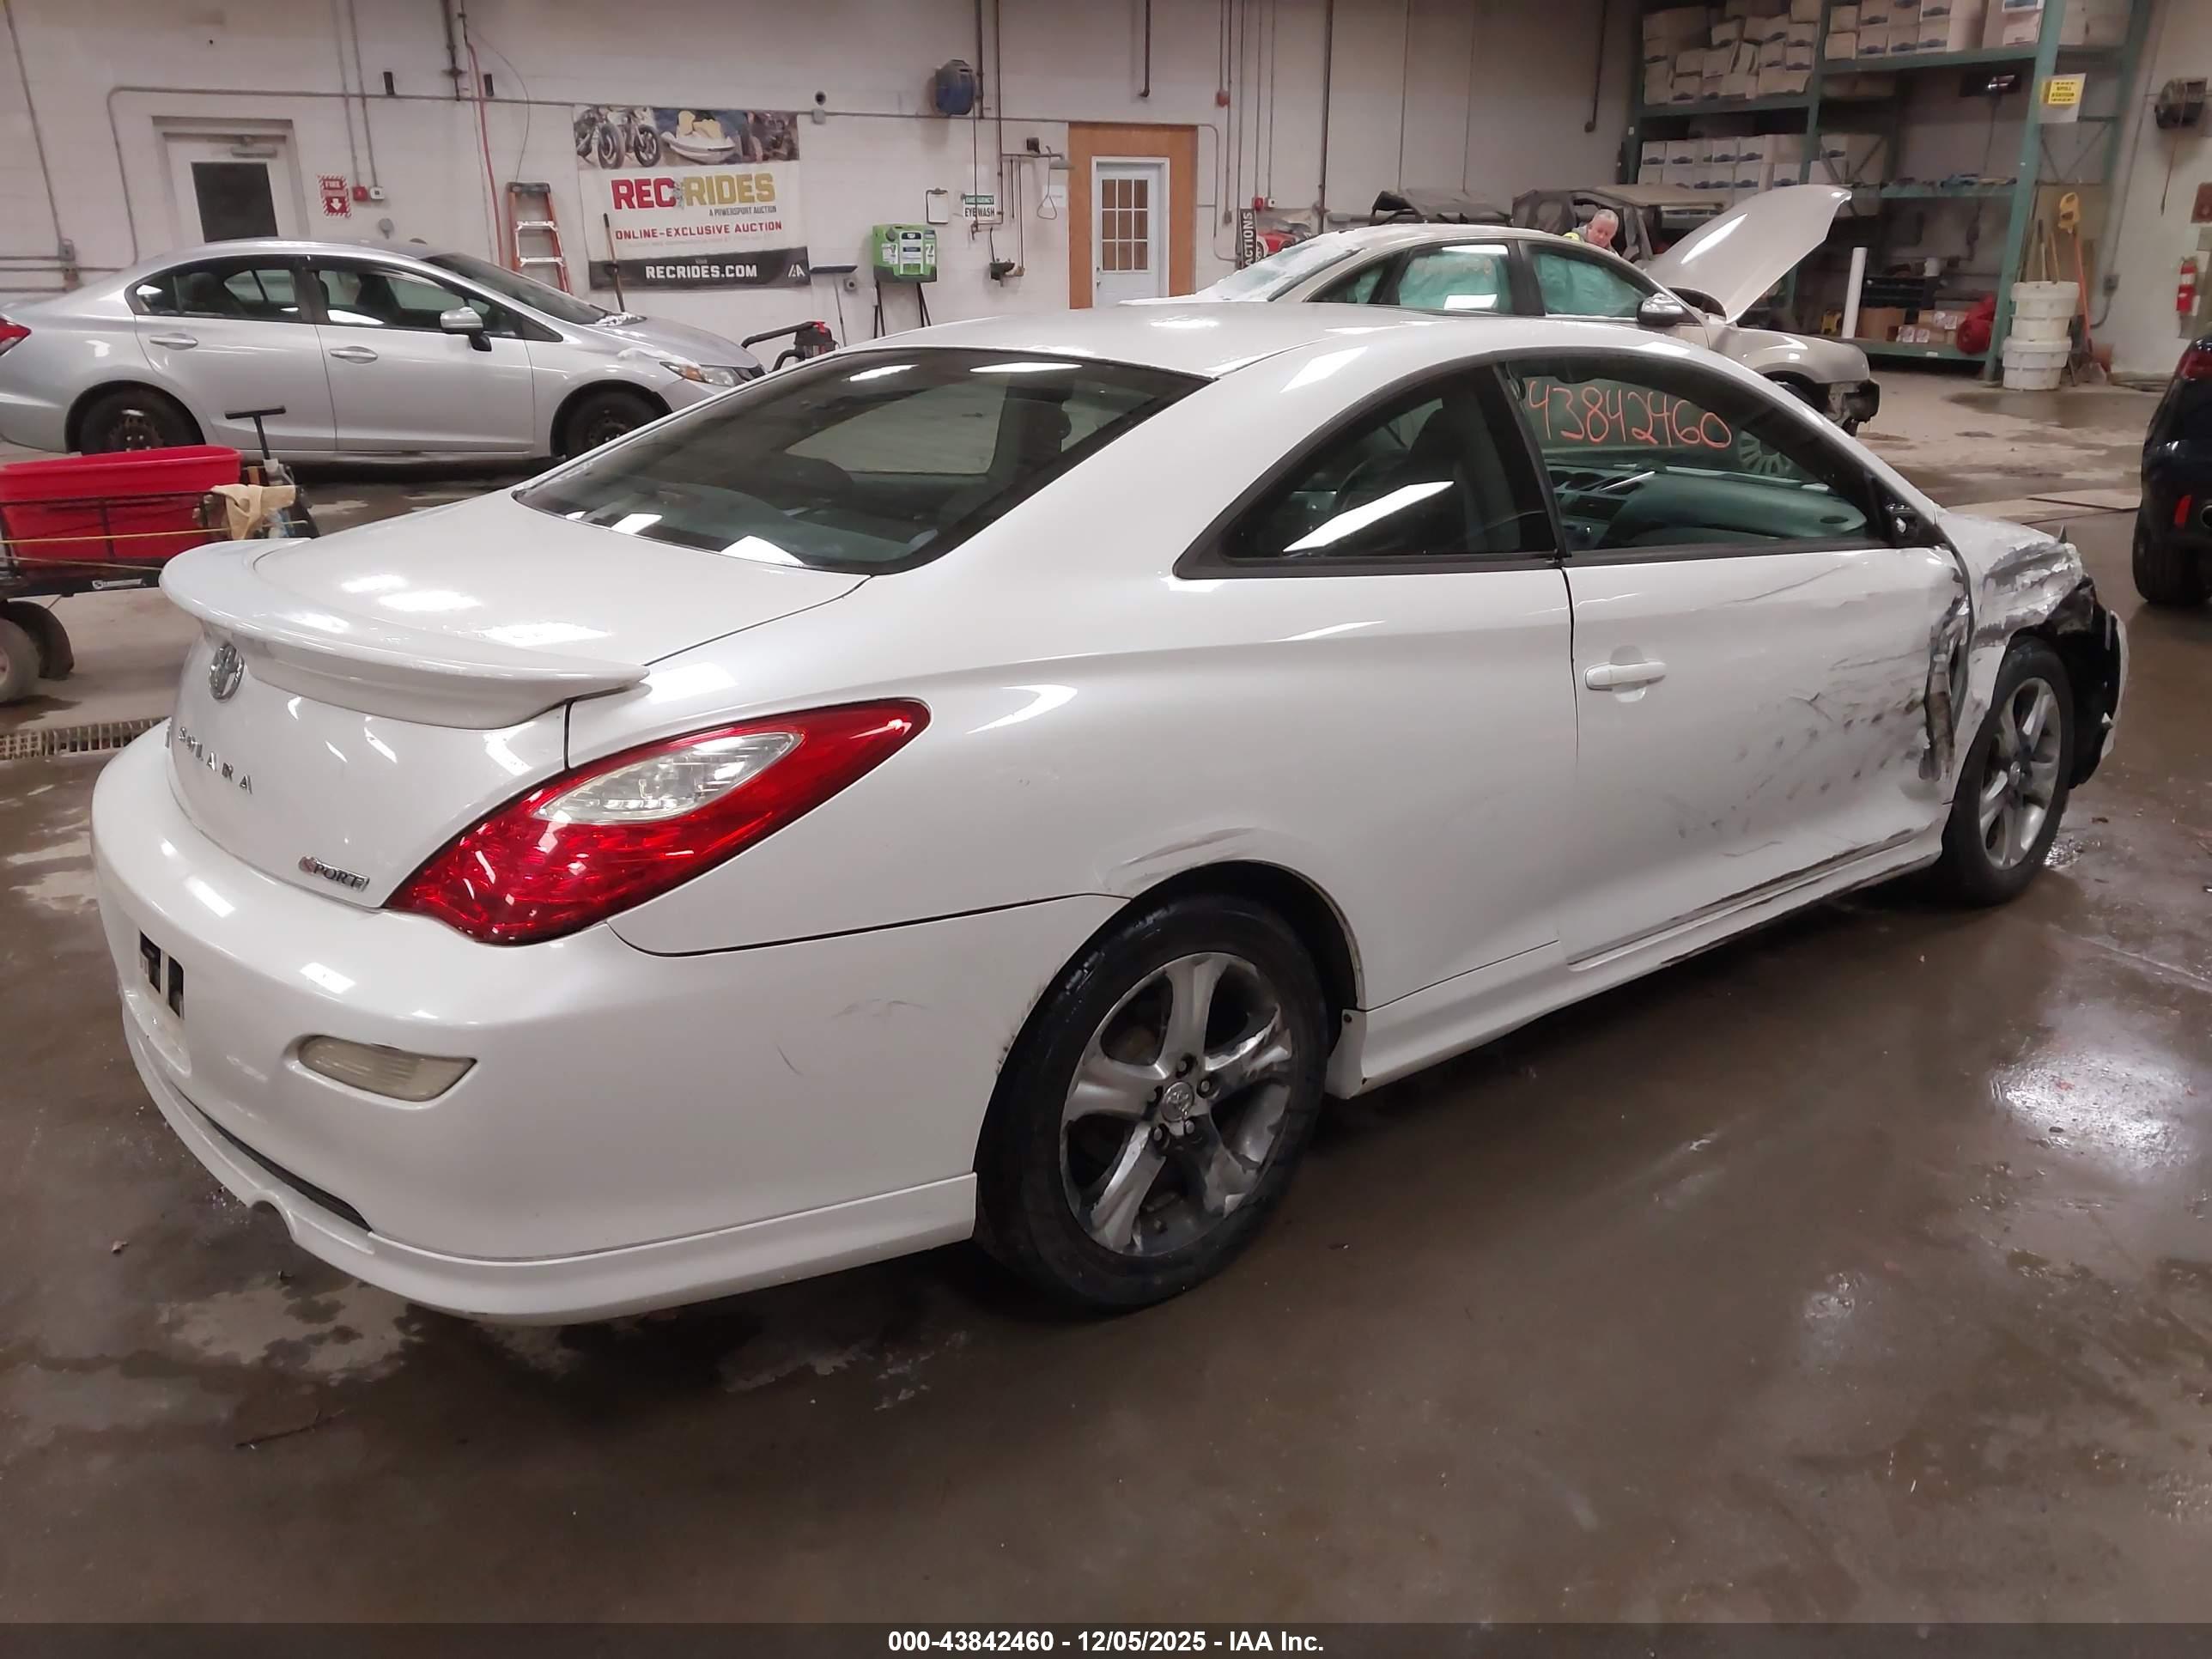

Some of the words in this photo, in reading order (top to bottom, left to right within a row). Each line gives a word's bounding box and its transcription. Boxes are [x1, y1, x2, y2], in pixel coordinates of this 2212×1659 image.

[611, 178, 677, 210] REC
[683, 173, 776, 207] RIDES
[753, 205, 777, 214] AUCTION
[964, 207, 976, 217] EYE
[977, 207, 995, 217] WASH
[615, 224, 731, 240] ONLINE-EXCLUSIVE
[734, 220, 782, 234] AUCTION
[645, 264, 757, 279] RECRIDES.COM
[1528, 380, 1733, 448] 43842460
